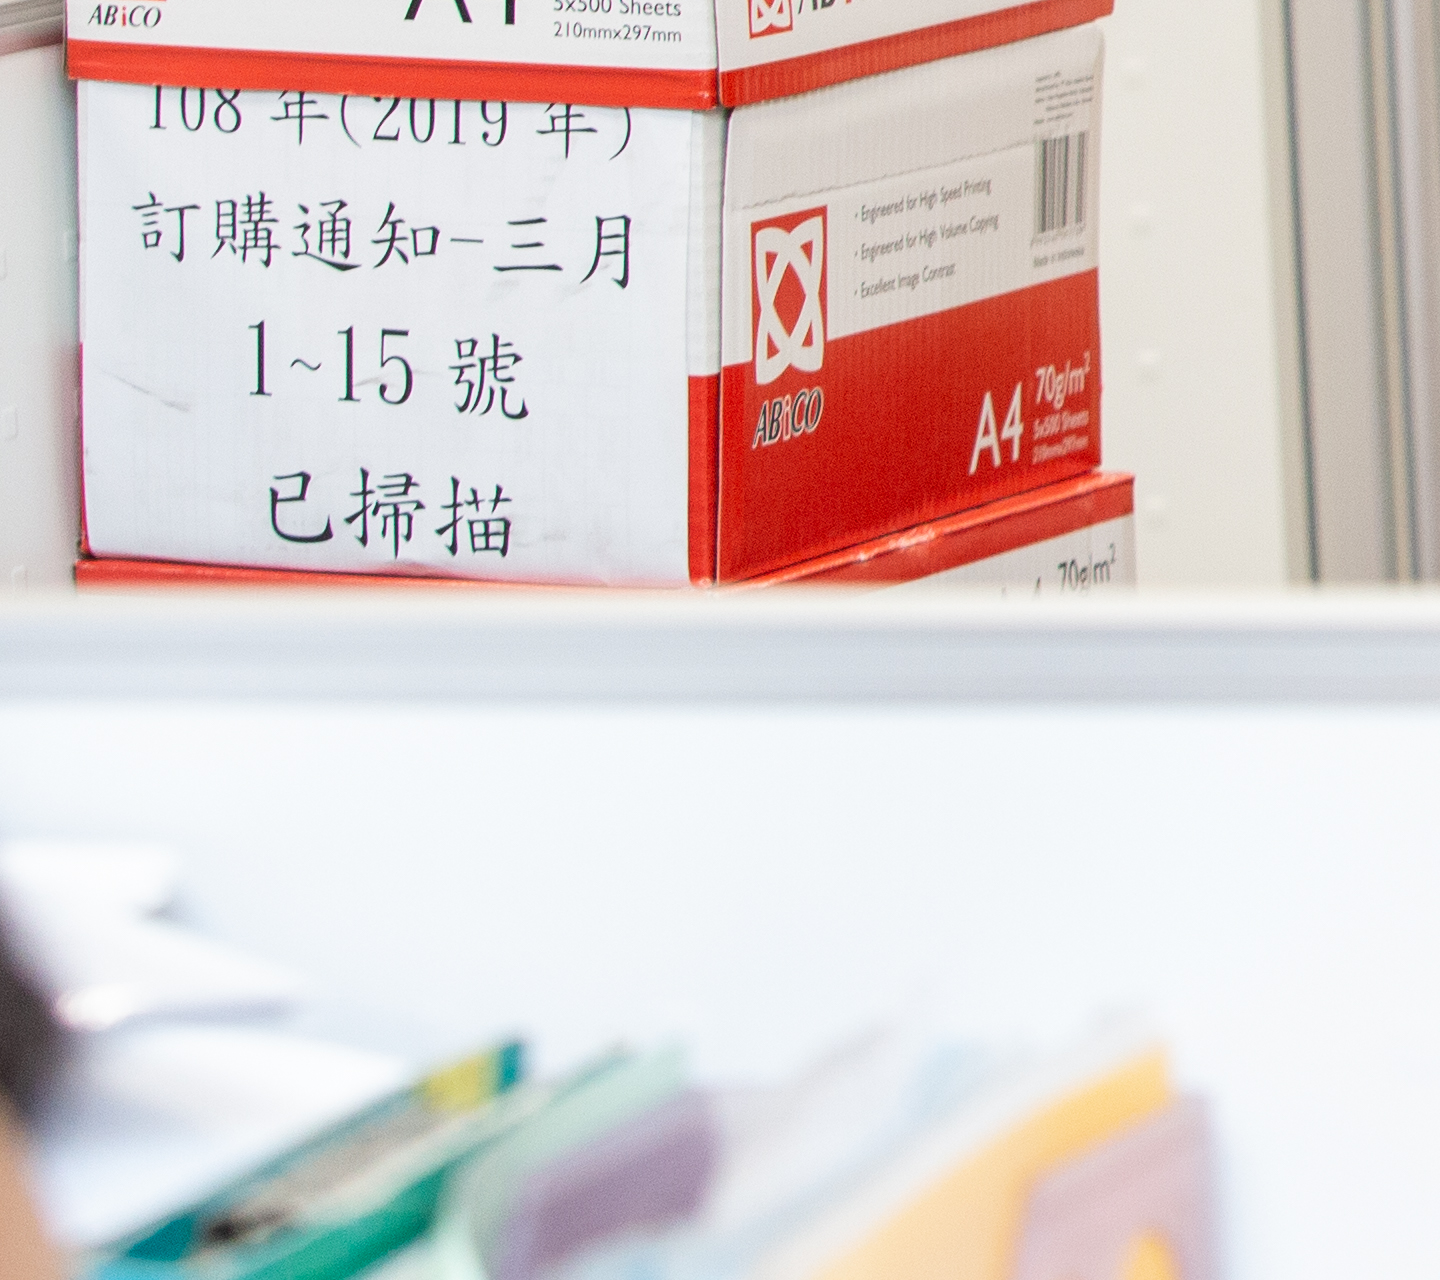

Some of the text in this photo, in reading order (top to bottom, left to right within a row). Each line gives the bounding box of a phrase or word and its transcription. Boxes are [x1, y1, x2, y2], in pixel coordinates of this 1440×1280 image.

[553, 21, 682, 43] 210mmx297mm
[920, 192, 937, 211] High
[920, 230, 937, 248] High
[449, 334, 529, 420] 號
[969, 382, 1023, 476] A4
